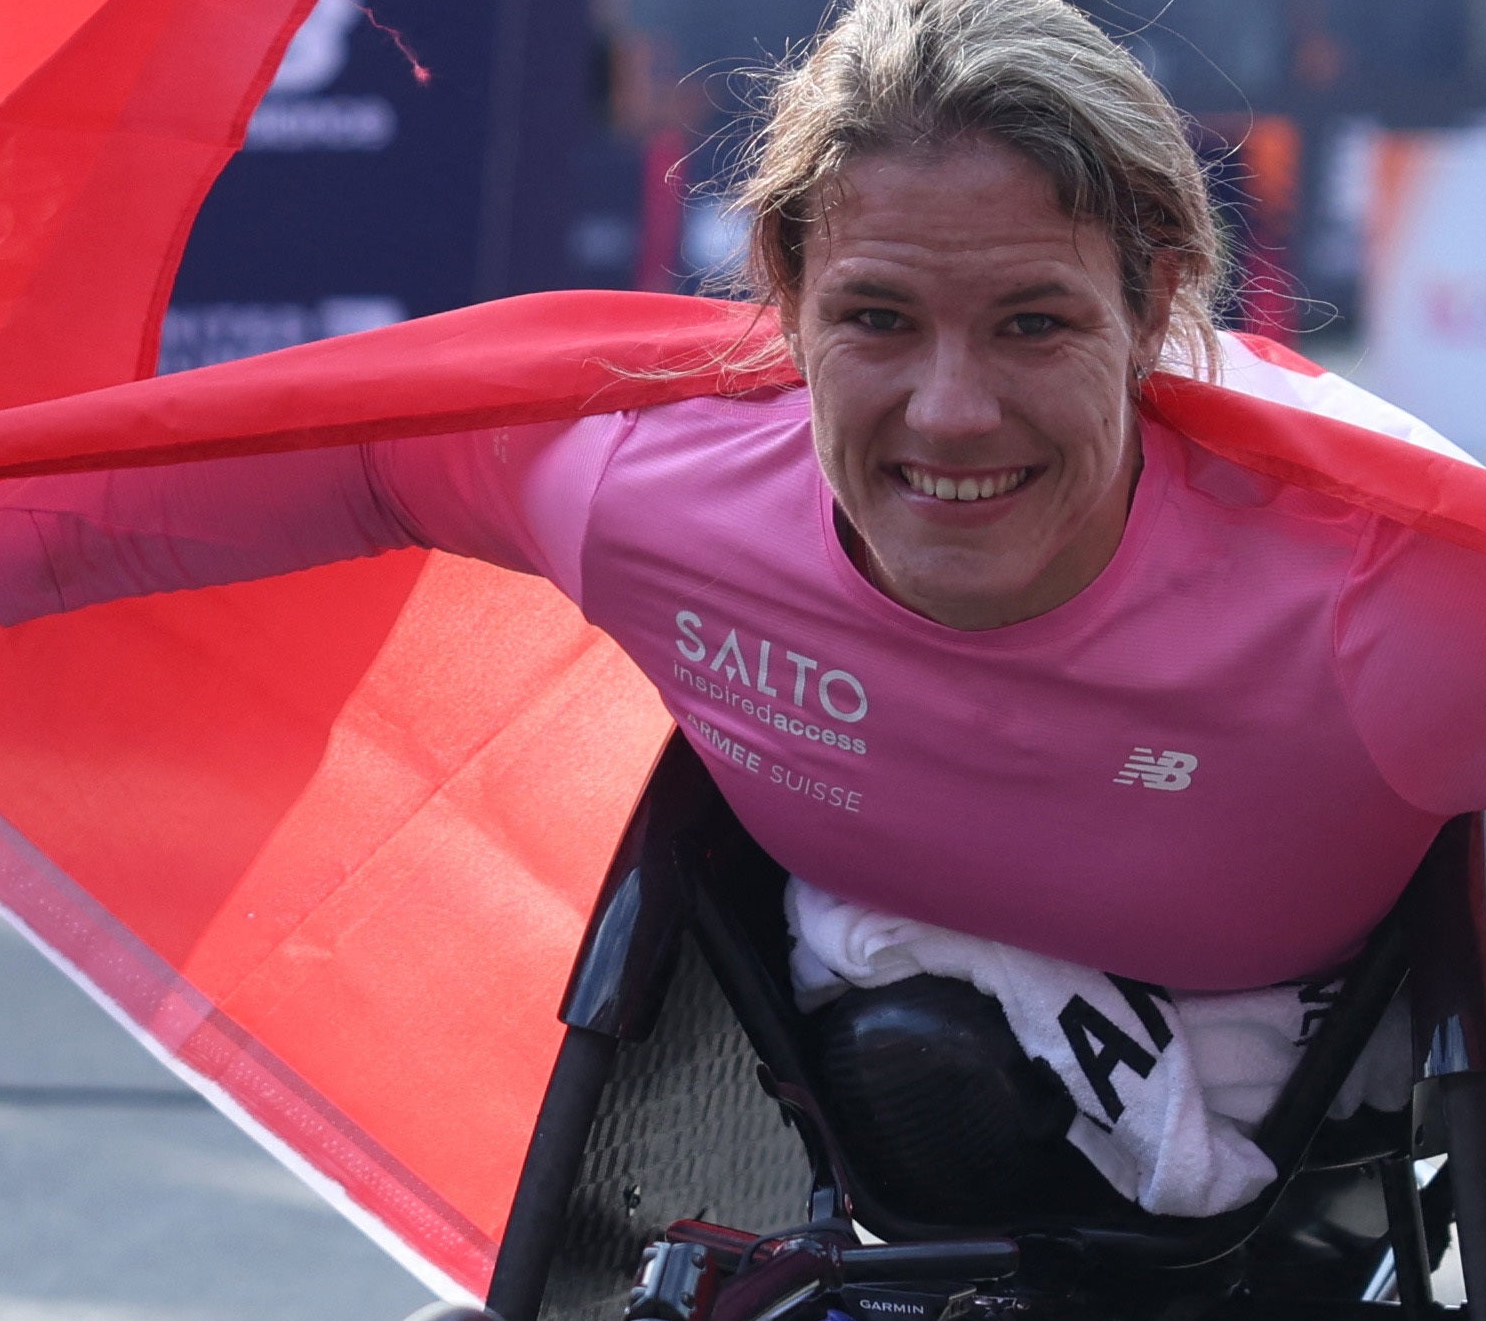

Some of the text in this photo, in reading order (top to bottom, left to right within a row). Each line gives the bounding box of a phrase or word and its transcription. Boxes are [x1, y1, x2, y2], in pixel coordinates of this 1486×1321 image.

[674, 661, 868, 755] inspiredaccess
[676, 610, 868, 723] SALTO
[687, 713, 863, 812] ARMEE SUISSE
[859, 1299, 925, 1315] GARMIN
